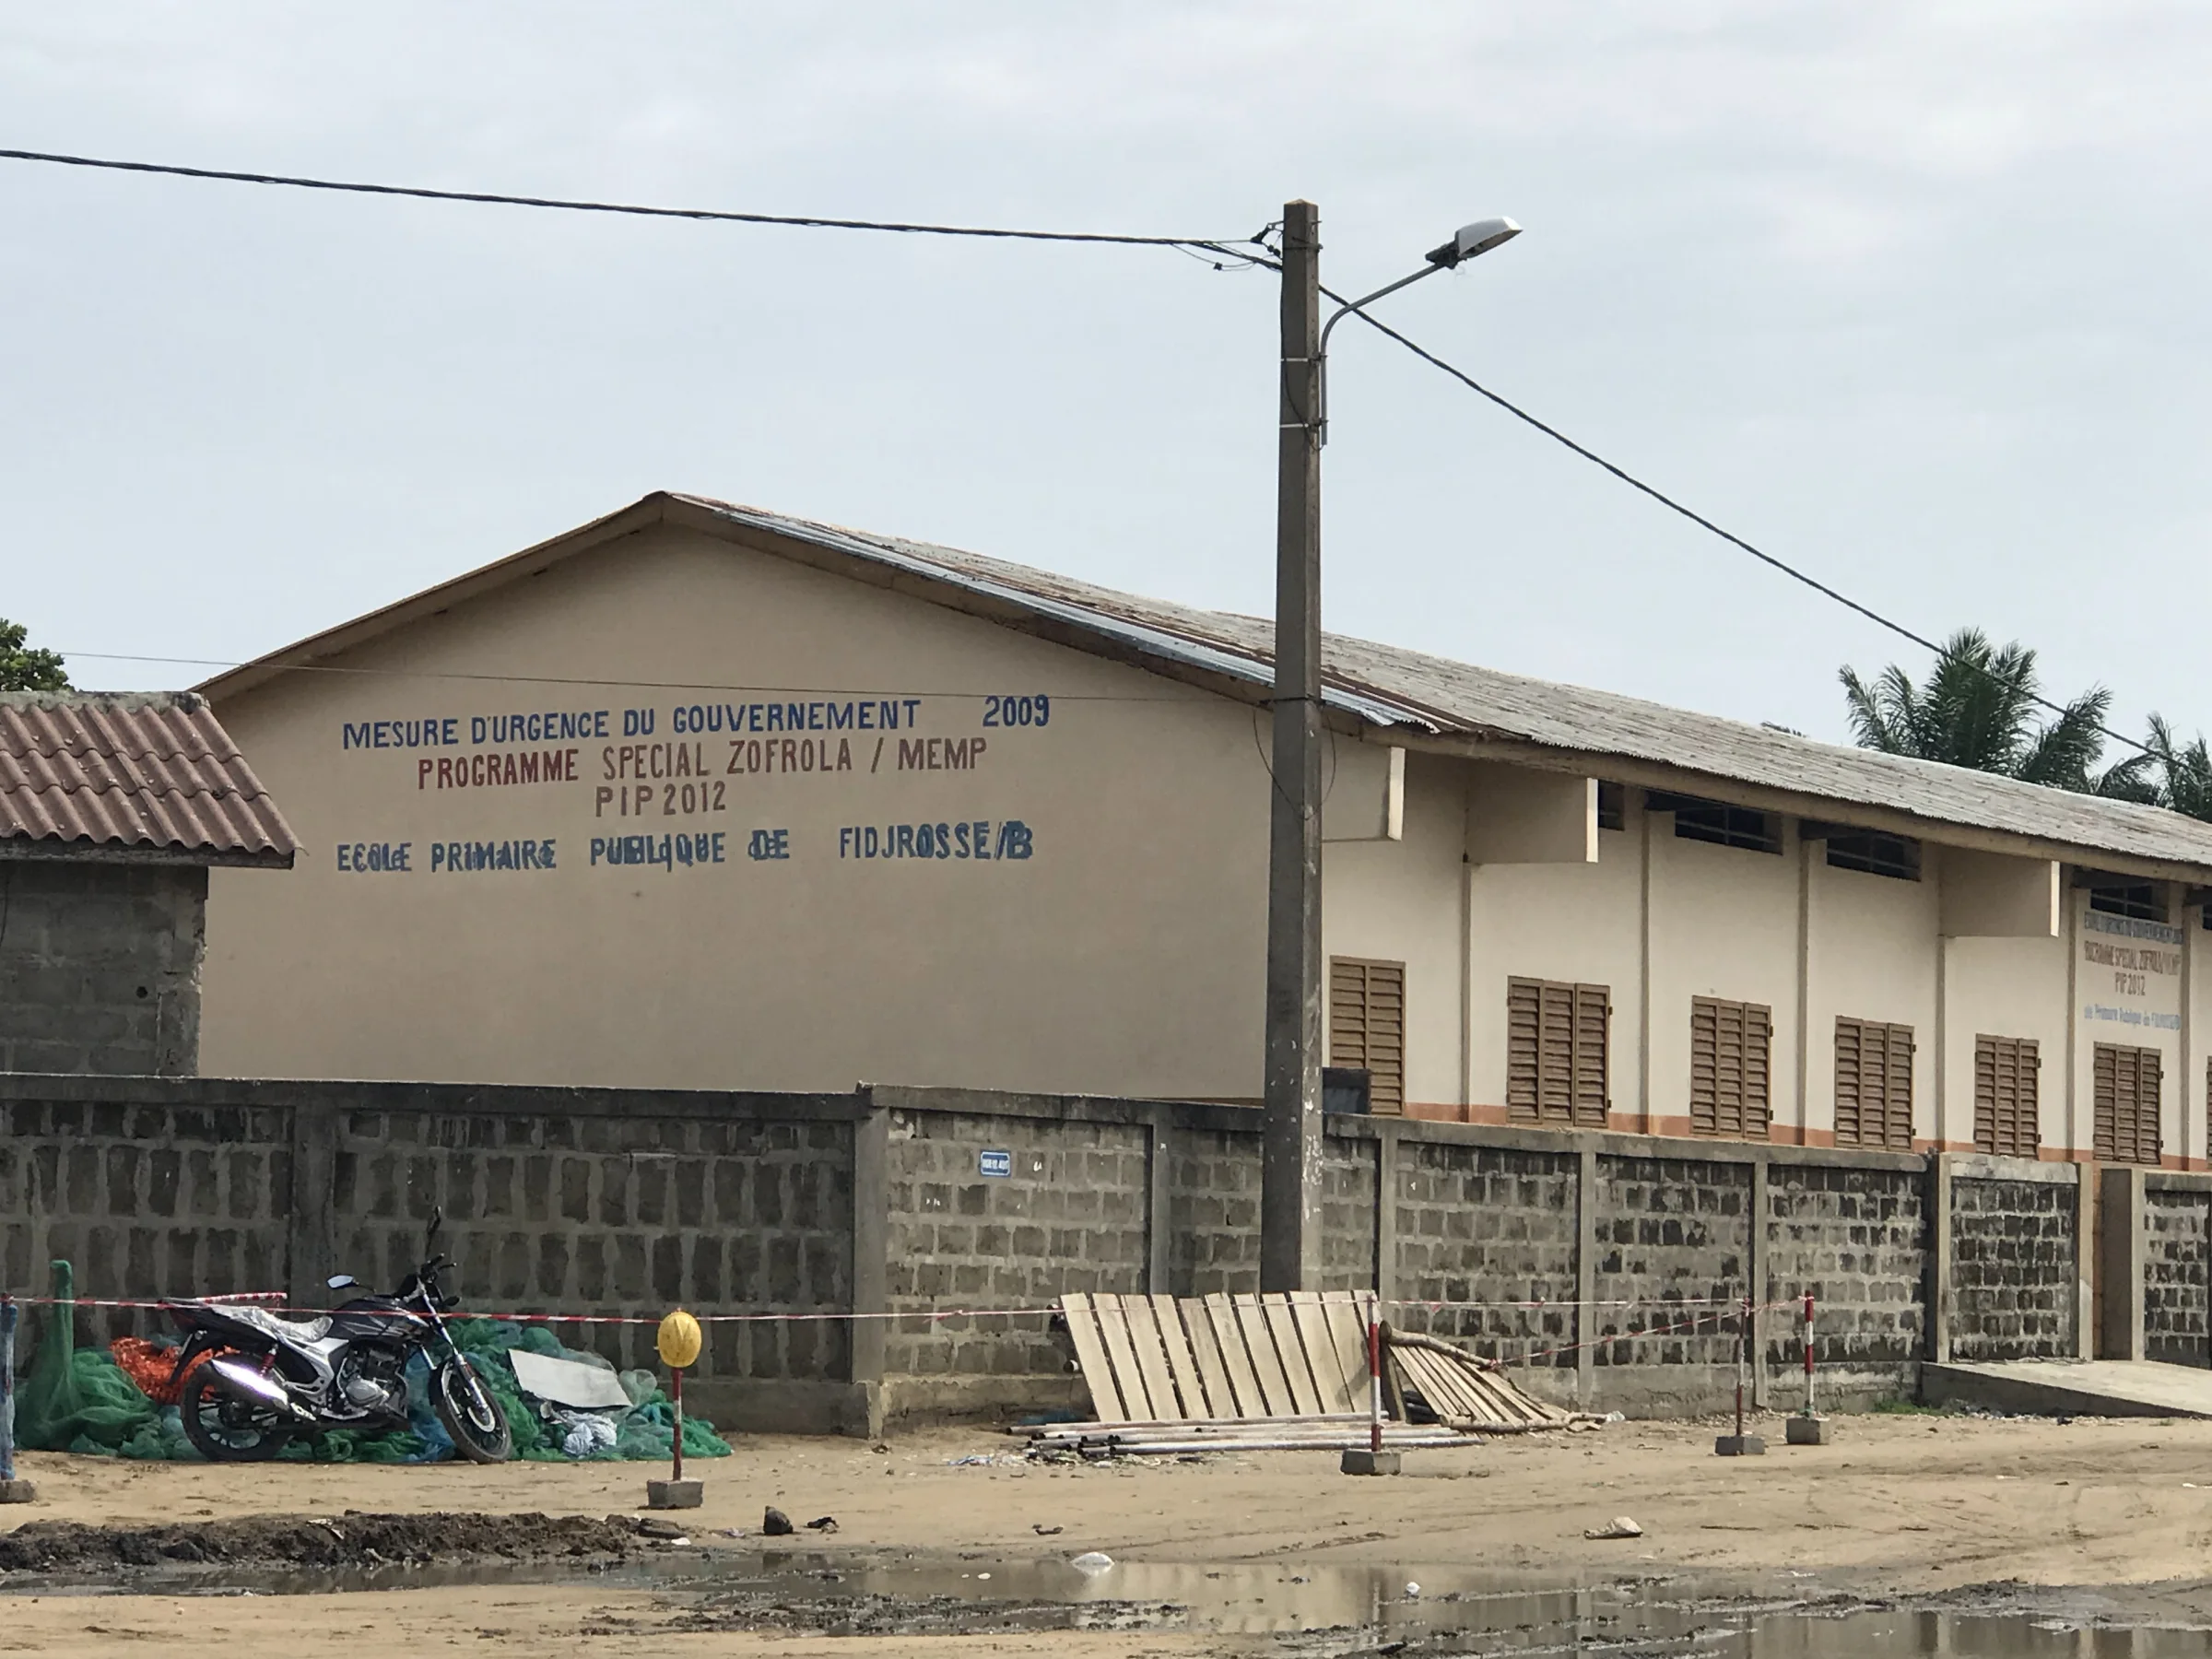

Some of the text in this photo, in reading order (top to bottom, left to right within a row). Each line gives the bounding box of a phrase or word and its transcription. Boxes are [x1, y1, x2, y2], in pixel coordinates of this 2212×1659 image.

[344, 694, 1050, 749] MESURE D'URGENCE DU GOUVERNEMENT 2009
[418, 737, 986, 790] PROGRAMME SPECIAL ZOFROLA / MEMP
[596, 781, 725, 818] PIP 2012
[337, 842, 412, 873] ECOLE
[431, 839, 557, 873] PRIMAIRE
[747, 830, 790, 861] DE
